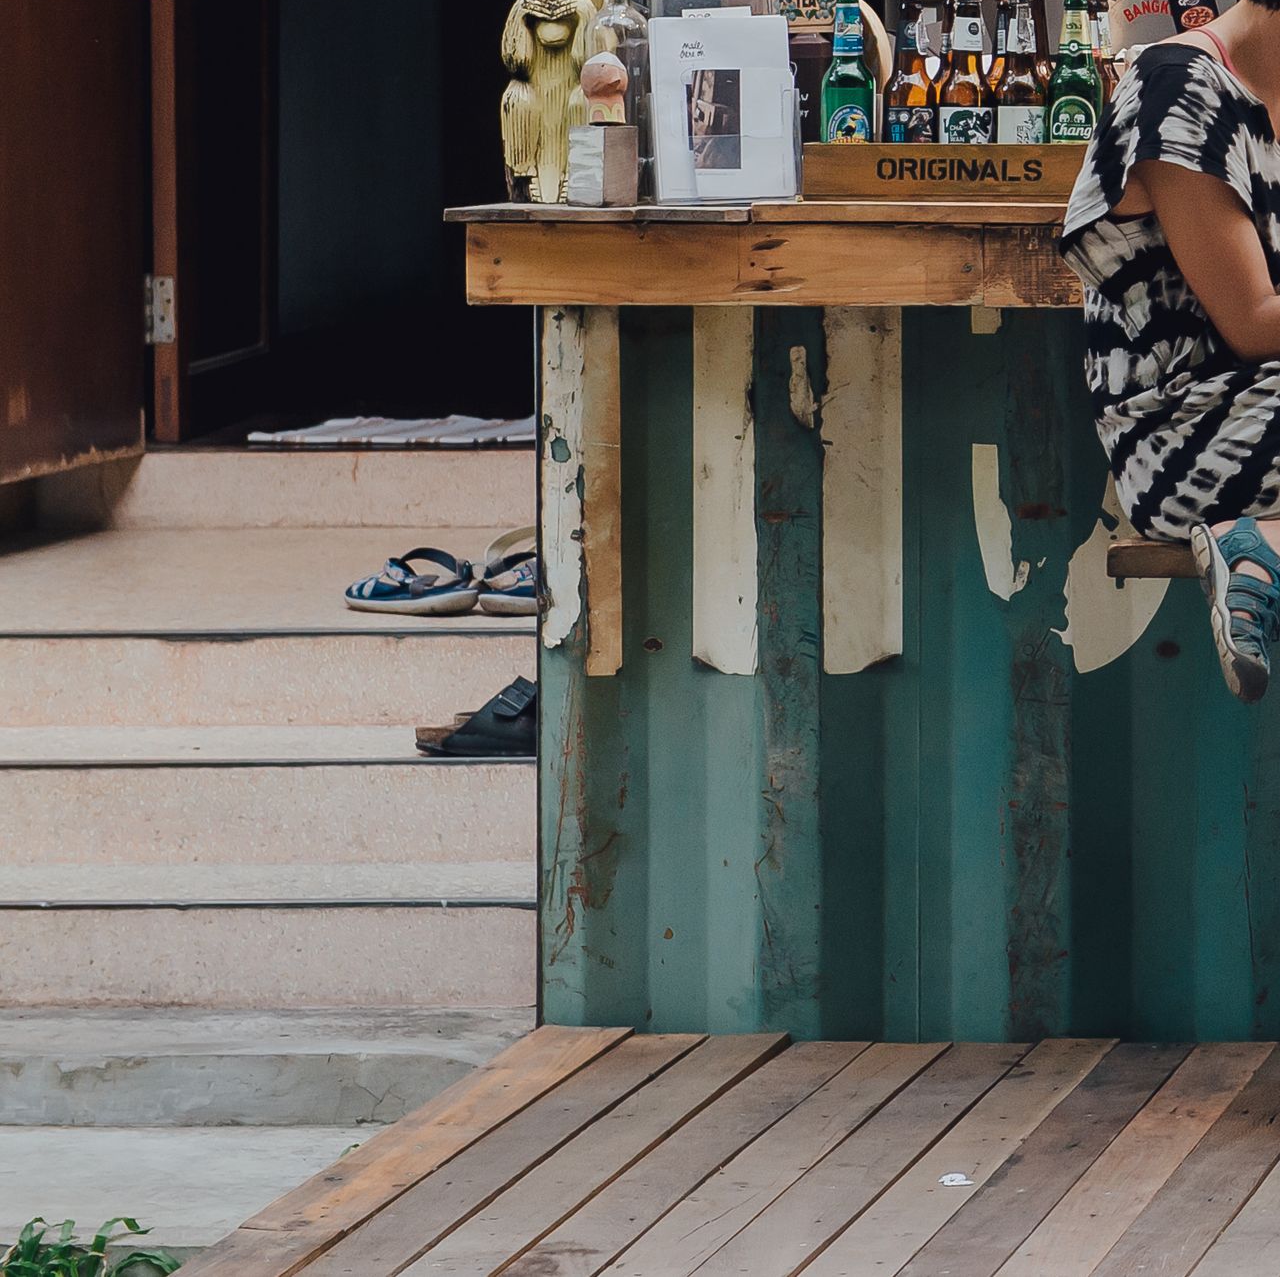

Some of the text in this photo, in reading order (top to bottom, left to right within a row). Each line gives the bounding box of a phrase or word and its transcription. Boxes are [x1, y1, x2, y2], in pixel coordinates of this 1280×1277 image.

[1123, 0, 1173, 23] BANGK
[1052, 122, 1092, 140] Chang
[876, 157, 1043, 182] ORIGINALS
